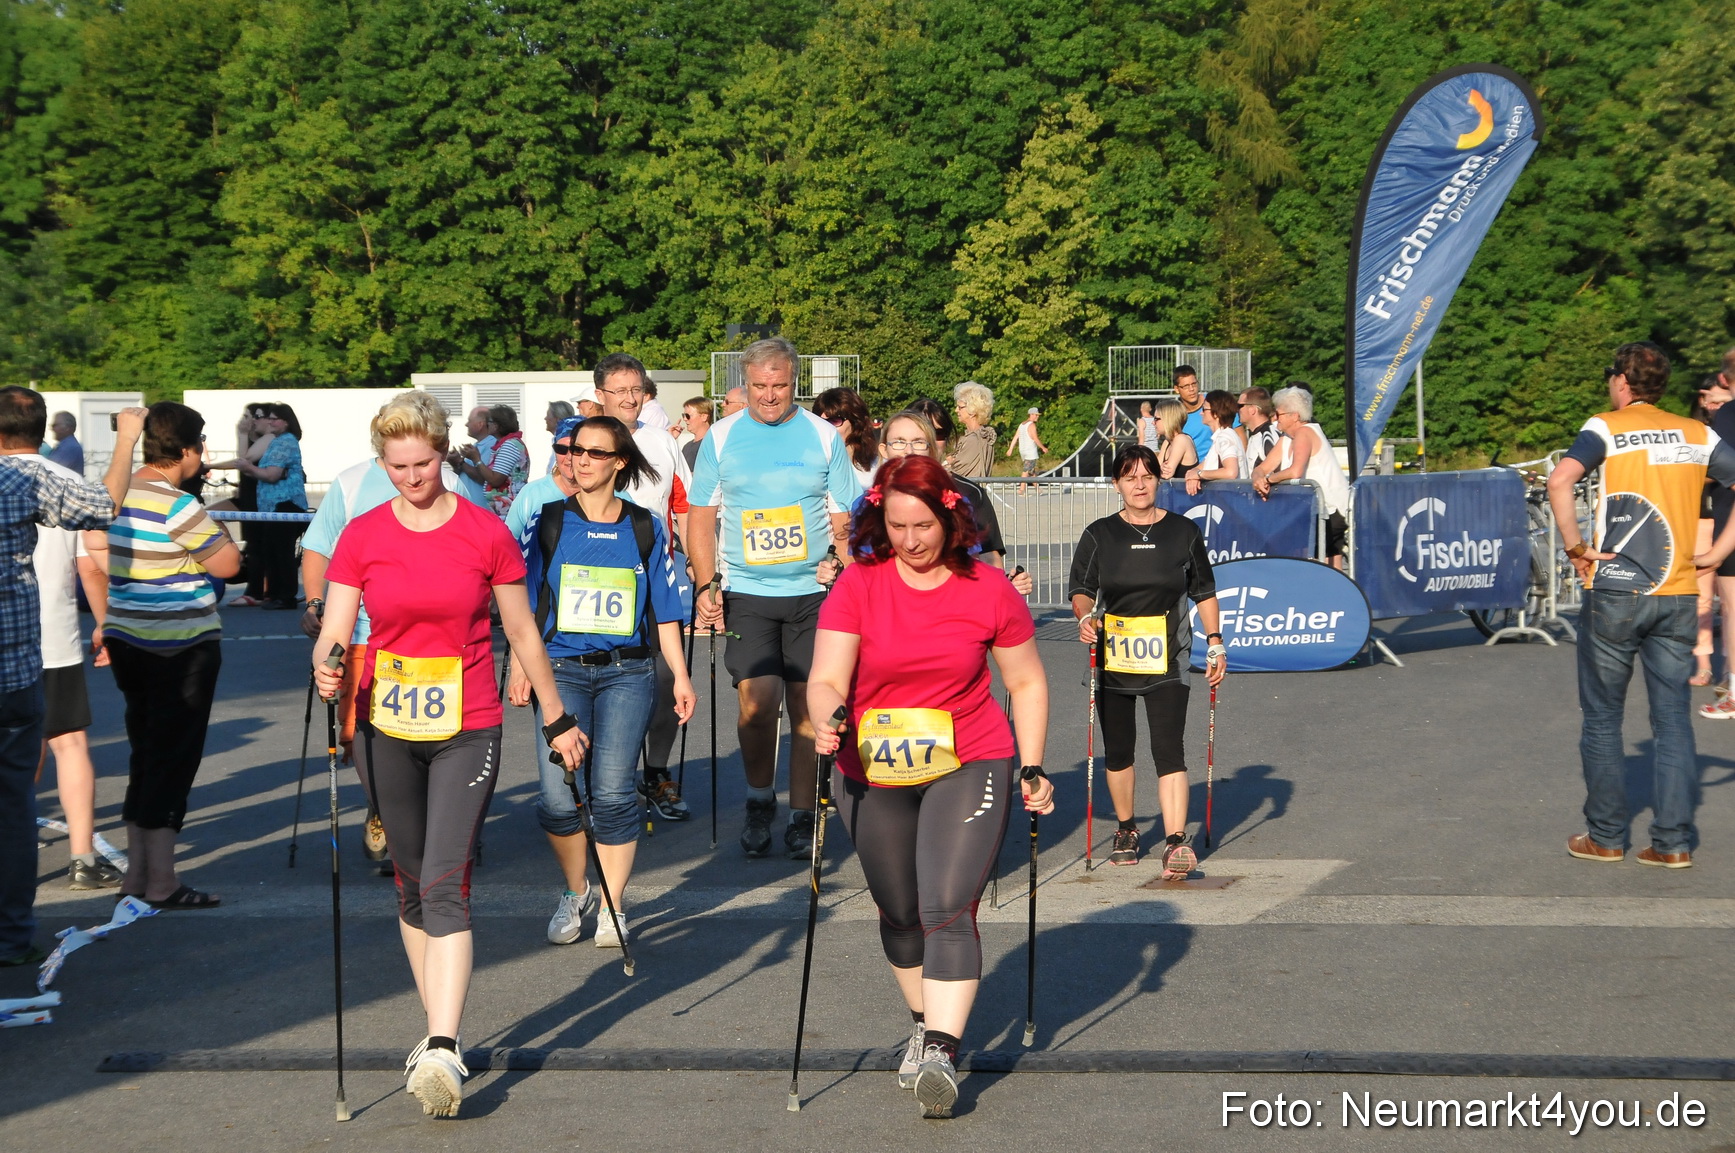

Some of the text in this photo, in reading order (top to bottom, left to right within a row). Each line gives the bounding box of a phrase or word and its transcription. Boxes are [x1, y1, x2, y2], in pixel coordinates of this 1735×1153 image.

[1448, 181, 1481, 223] Druck
[1477, 155, 1500, 181] und
[1363, 155, 1485, 320] Frischmann
[1363, 295, 1434, 421] www.frischmann-net.de
[1614, 430, 1681, 449] Benzin
[1655, 446, 1709, 464] im Blut
[1611, 515, 1632, 523] km/h
[587, 531, 618, 540] hummel
[745, 525, 803, 551] 1385
[1416, 530, 1502, 570] Fischer
[1423, 573, 1497, 592] AUTOMOBILE
[1606, 568, 1637, 578] Fischer
[570, 588, 623, 618] 716
[1219, 607, 1344, 633] Fischer
[1107, 635, 1163, 659] 1100
[1228, 633, 1336, 647] AUTOMOBILE
[381, 684, 446, 719] 418
[873, 739, 937, 768] 417
